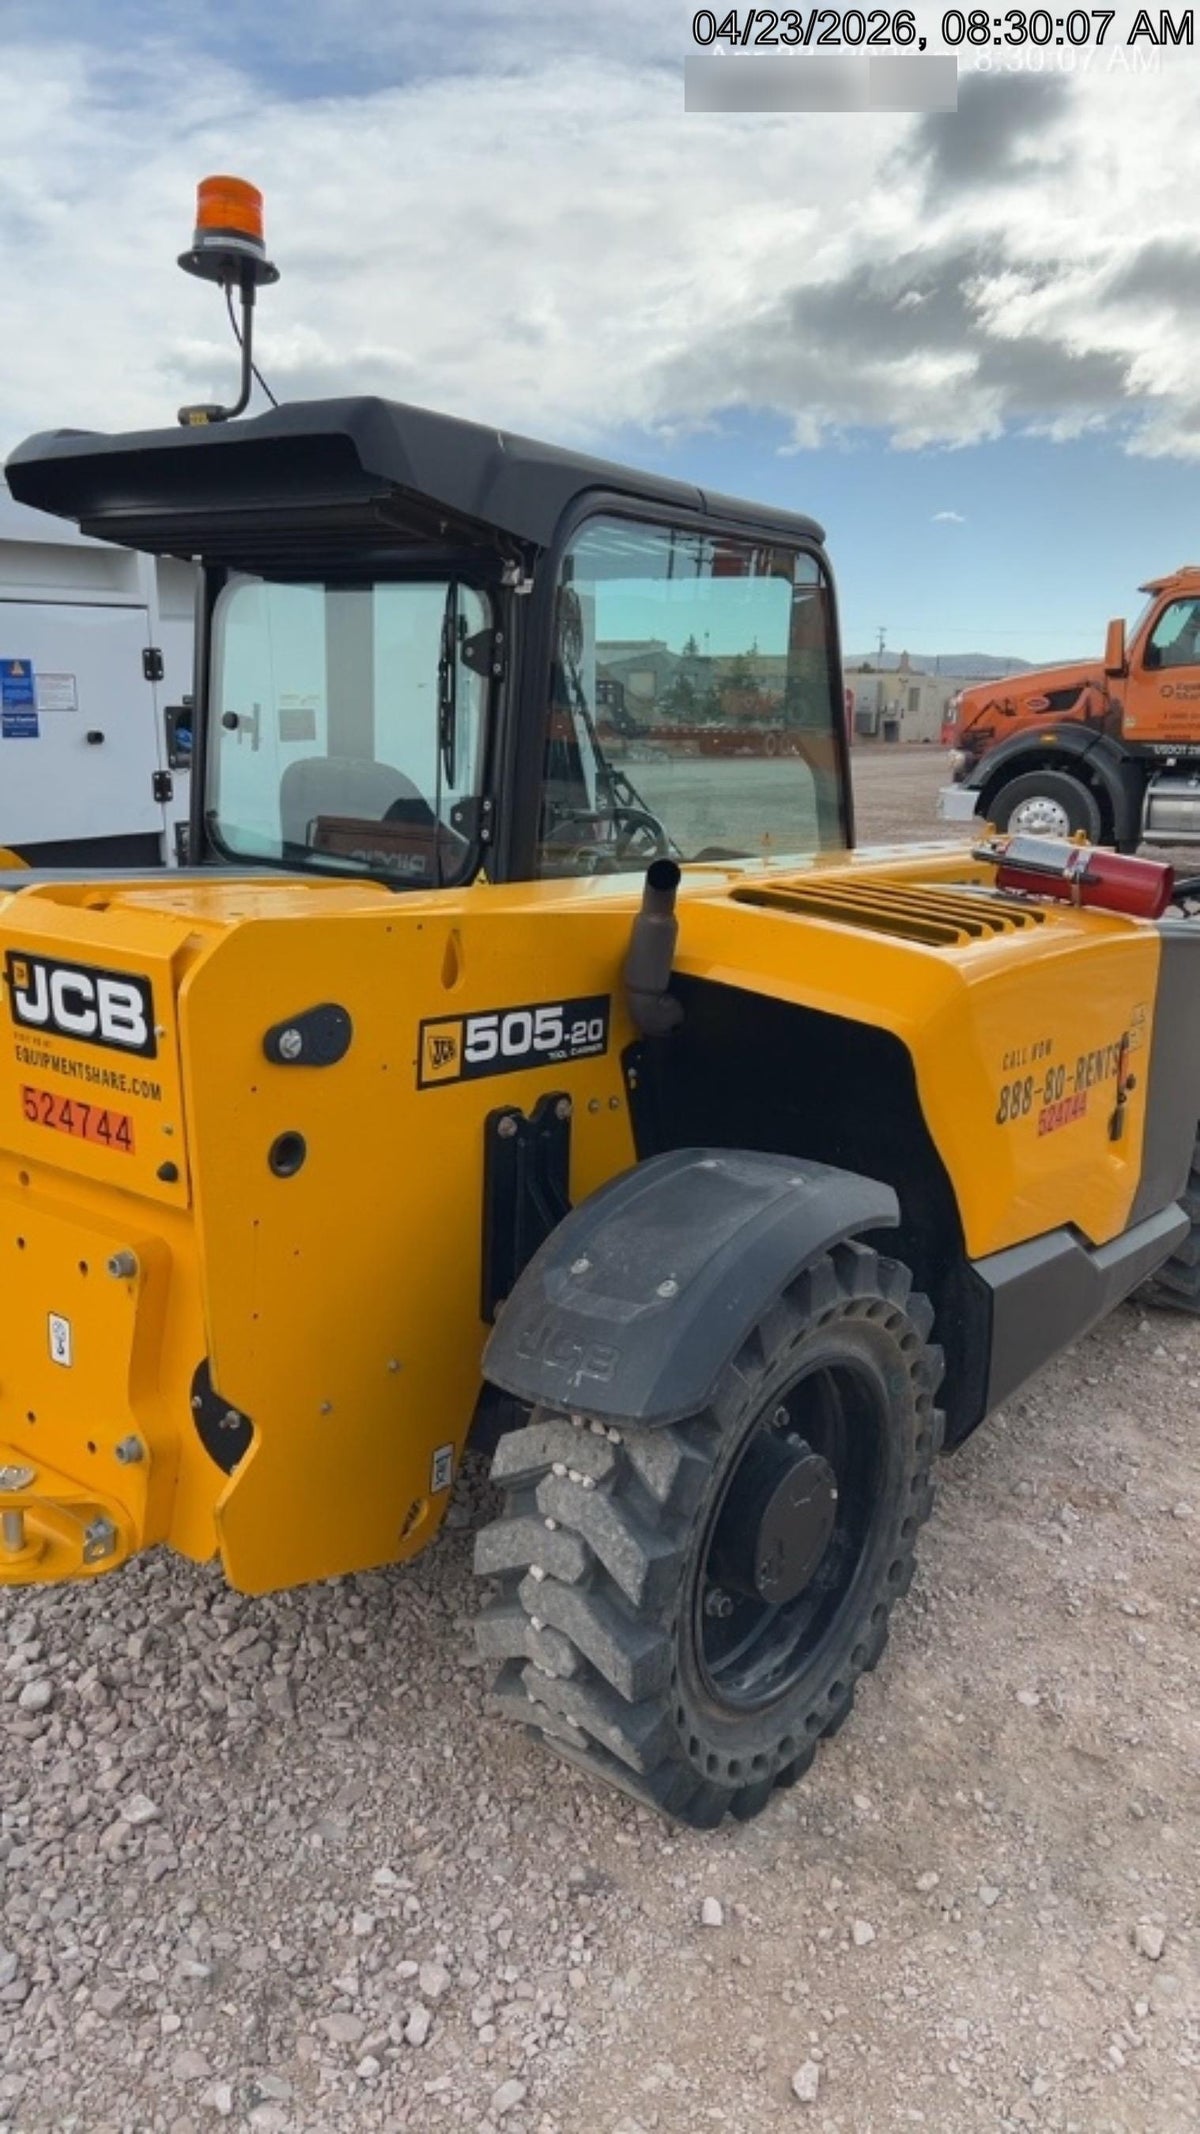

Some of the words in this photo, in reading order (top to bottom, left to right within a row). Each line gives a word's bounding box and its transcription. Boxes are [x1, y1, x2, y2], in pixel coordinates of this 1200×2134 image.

[16, 965, 147, 1047] JCB
[16, 1045, 162, 1101] EQUIPMENTSHARE.COM
[1002, 1047, 1027, 1071] CALL
[23, 1087, 133, 1151] 524744
[515, 1326, 624, 1383] JCB
